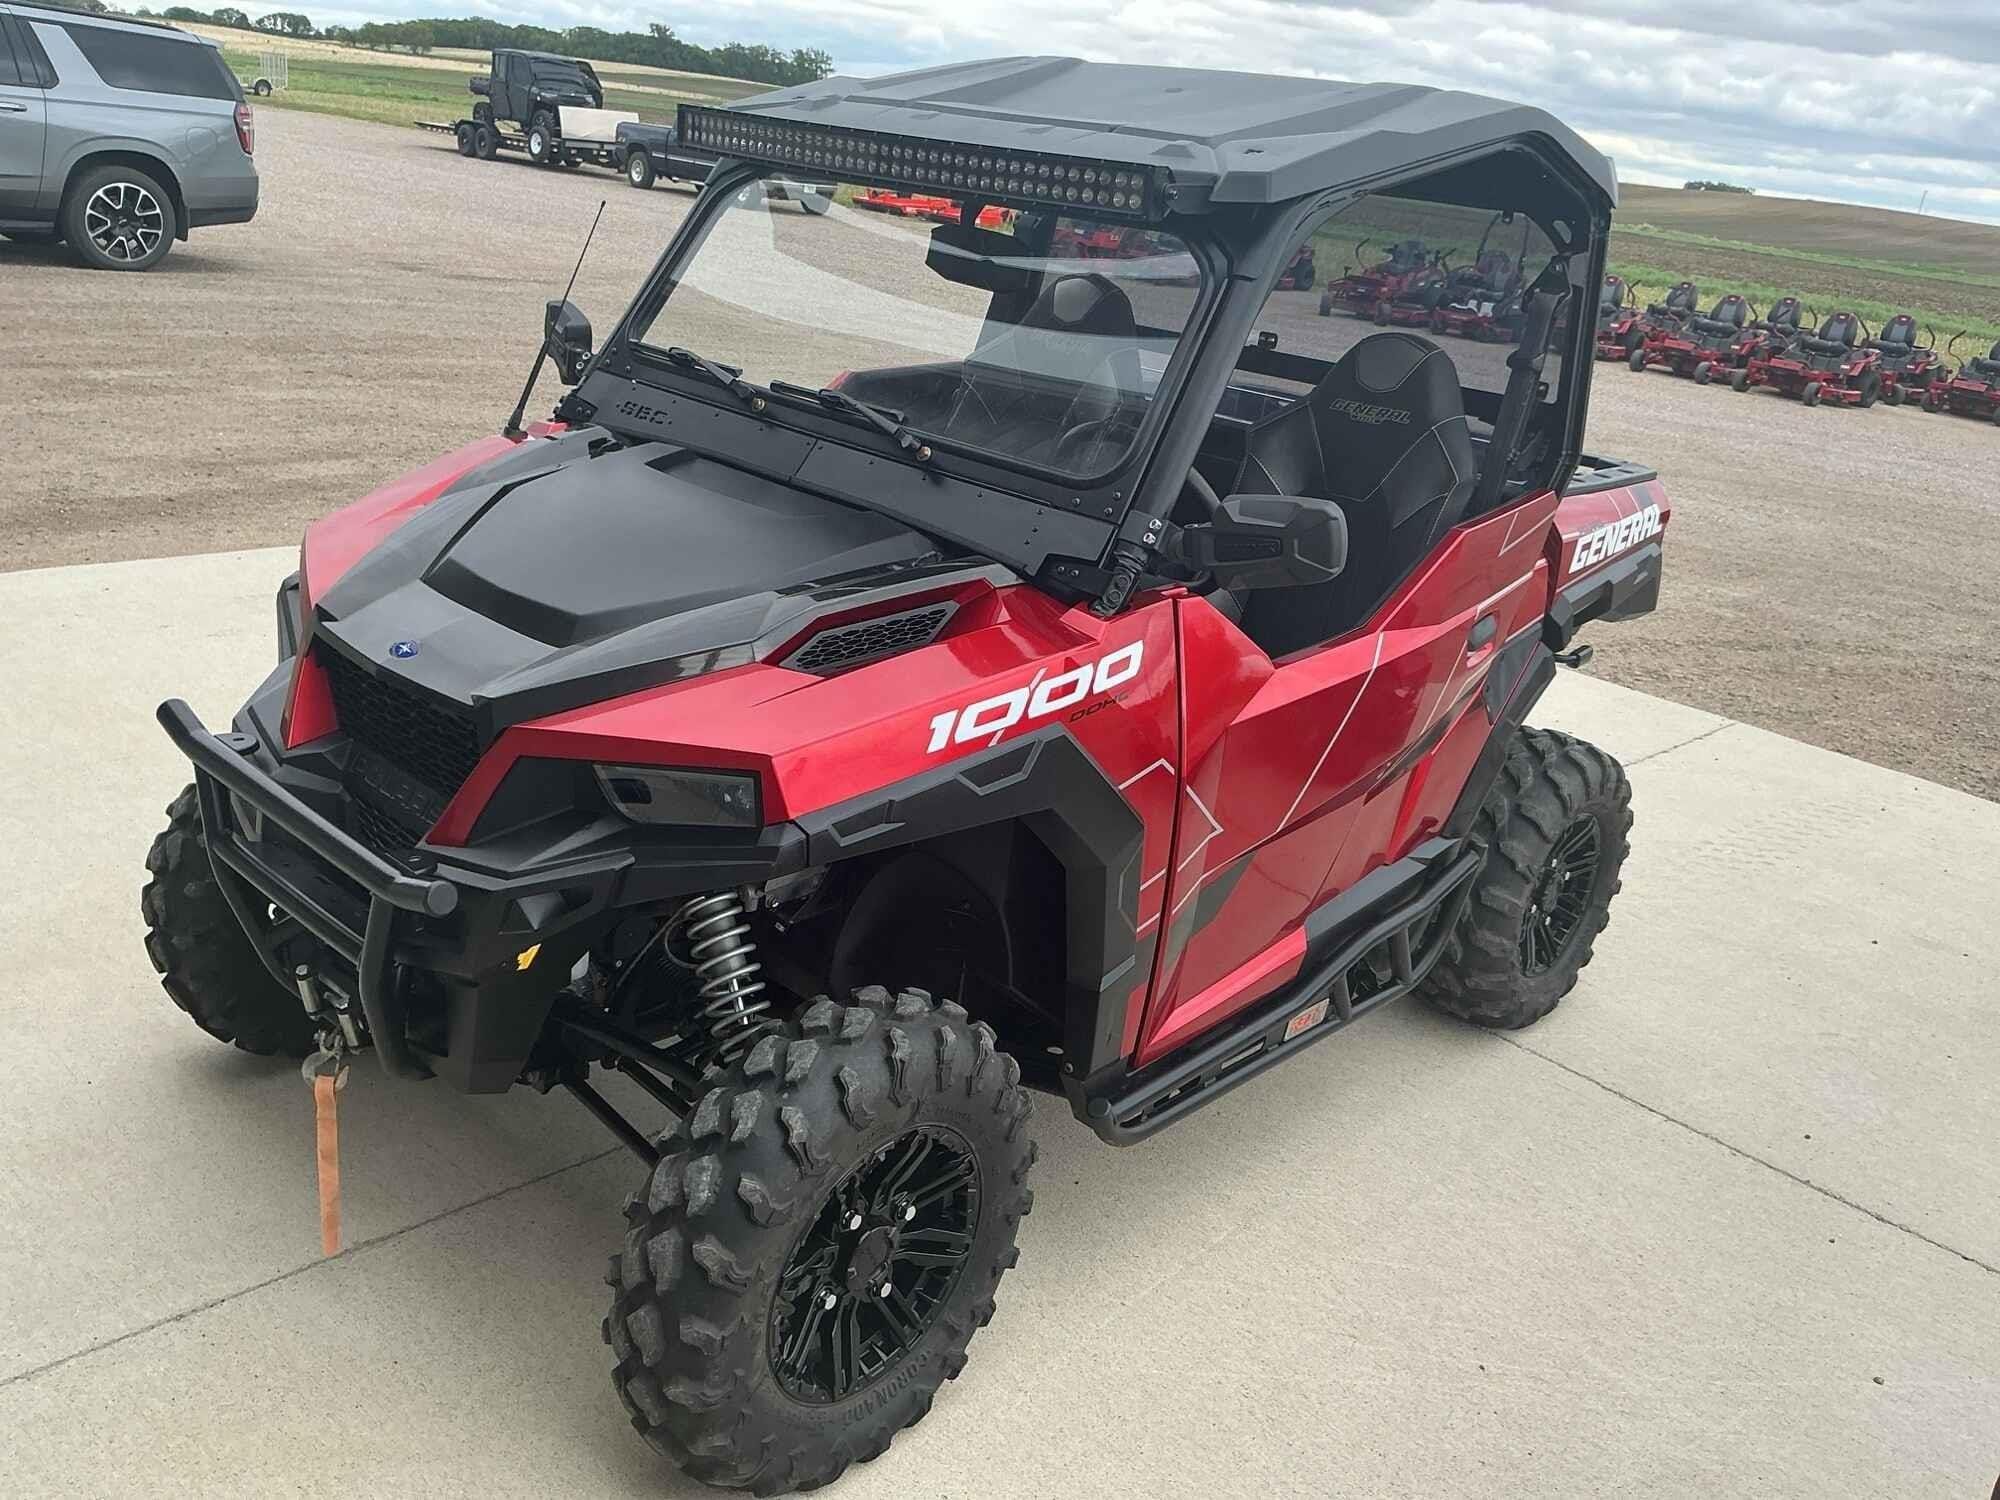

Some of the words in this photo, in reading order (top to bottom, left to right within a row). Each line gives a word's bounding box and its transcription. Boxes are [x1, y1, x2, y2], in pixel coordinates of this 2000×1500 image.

[1329, 398, 1410, 424] GENERAL
[1568, 503, 1663, 574] GENERAL
[926, 639, 1144, 755] 1000
